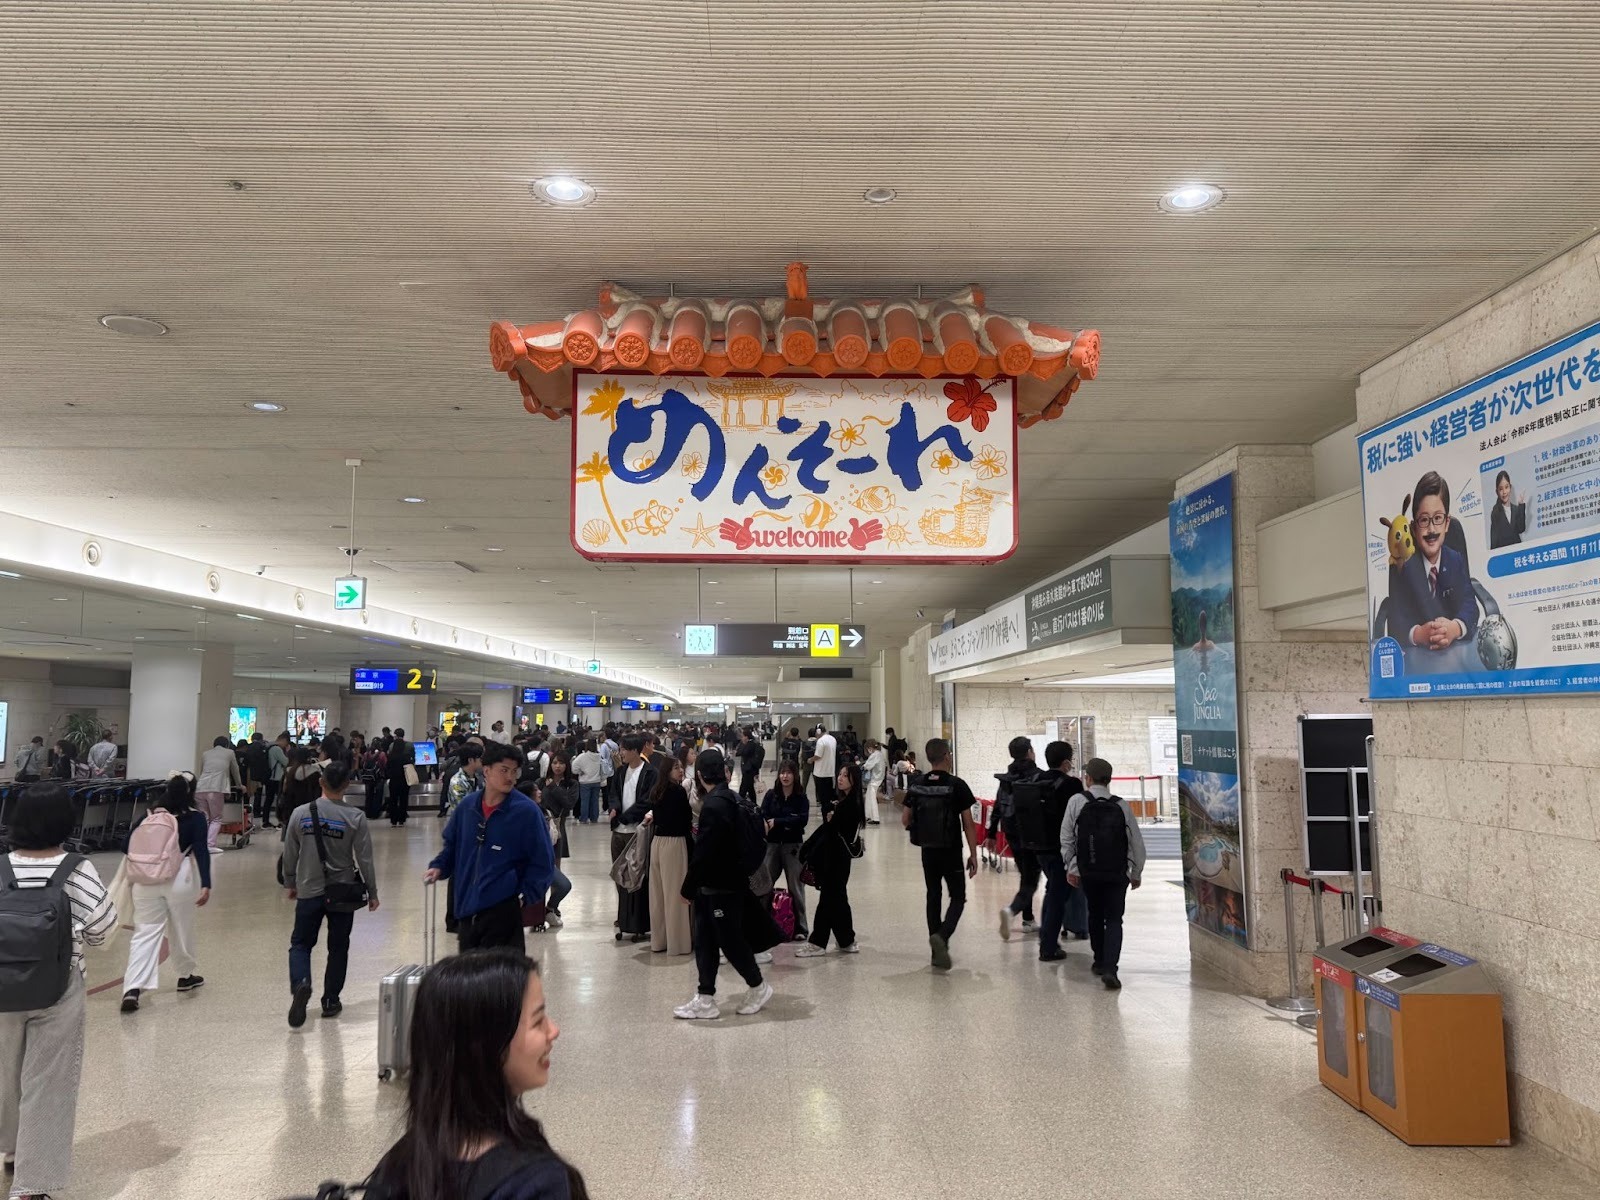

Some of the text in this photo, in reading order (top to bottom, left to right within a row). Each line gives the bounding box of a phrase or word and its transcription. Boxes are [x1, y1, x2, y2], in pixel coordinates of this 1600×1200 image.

[1366, 347, 1600, 473] 税に強い経営者が次世代を
[608, 389, 973, 510] めんそーれ
[1541, 434, 1600, 462] 税・財政改革のあり
[750, 528, 848, 549] welcome
[1514, 549, 1567, 568] 税を考える週間
[818, 630, 833, 646] A
[407, 668, 421, 689] 2
[1194, 672, 1218, 706] Spa
[554, 689, 564, 702] 3
[599, 695, 608, 705] 4
[1193, 703, 1222, 725] JUNGLIA
